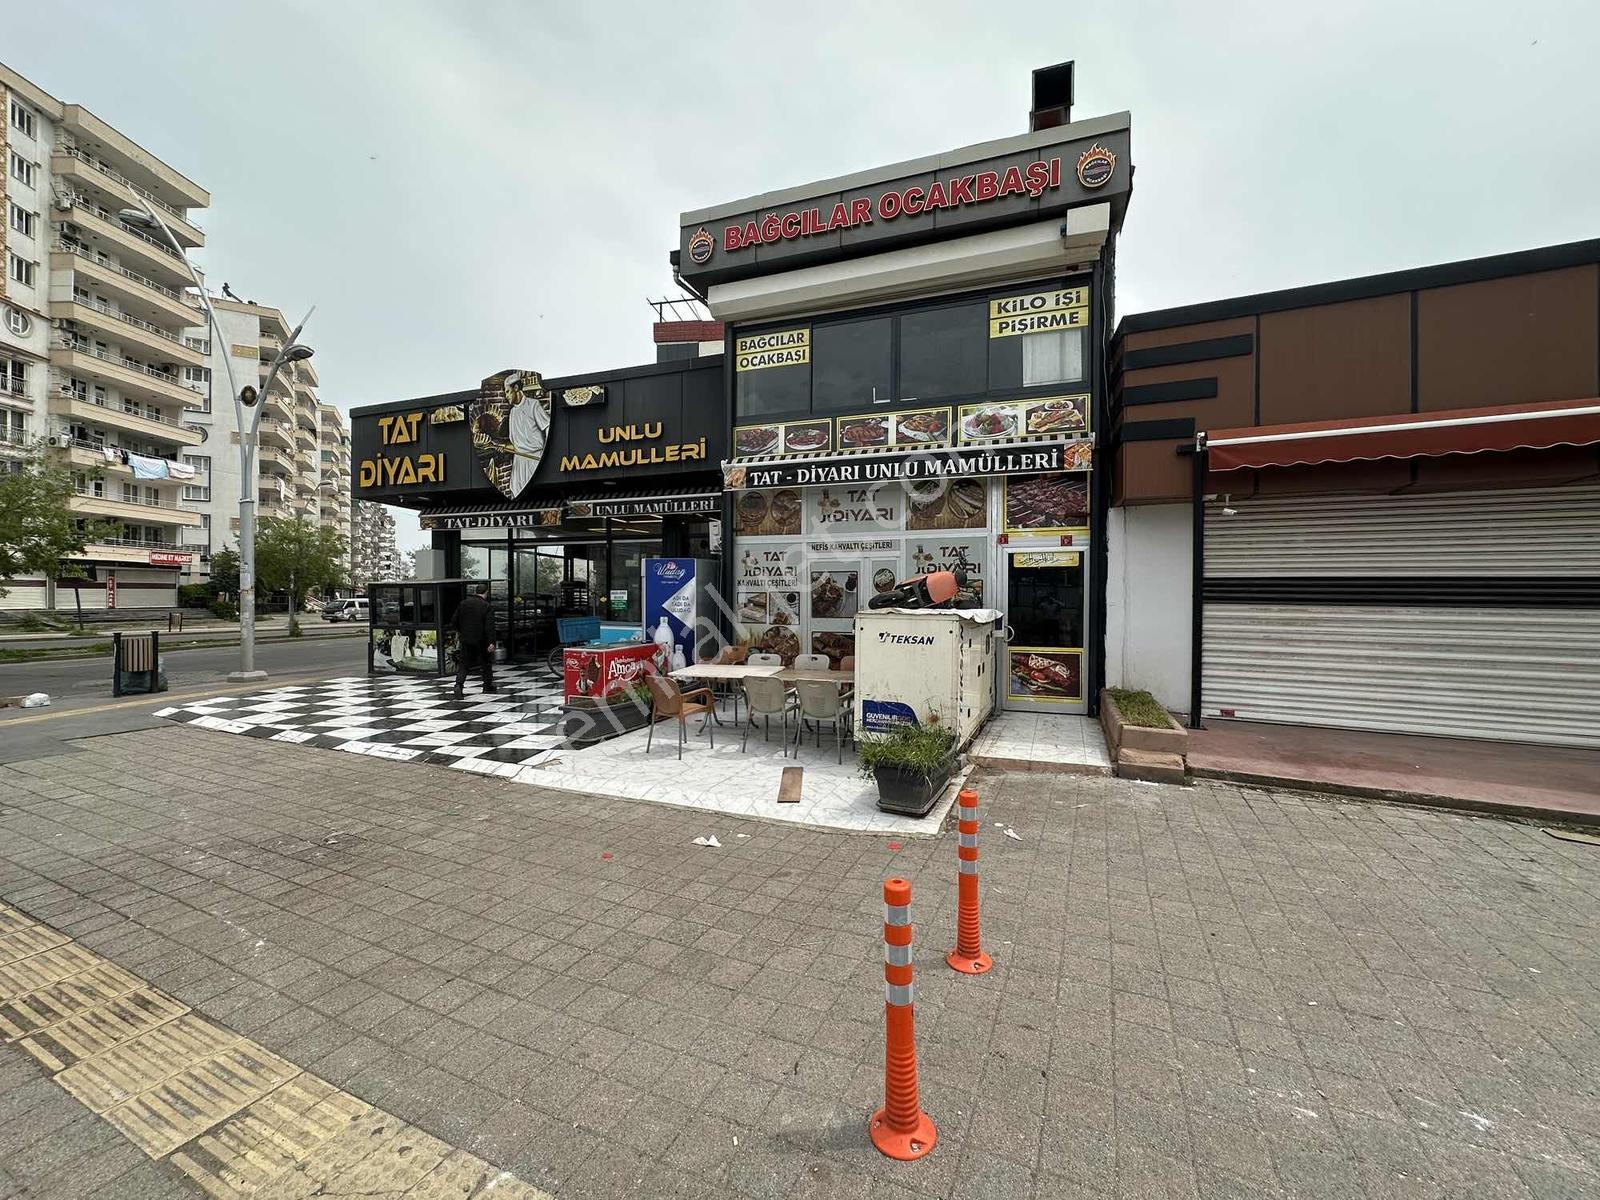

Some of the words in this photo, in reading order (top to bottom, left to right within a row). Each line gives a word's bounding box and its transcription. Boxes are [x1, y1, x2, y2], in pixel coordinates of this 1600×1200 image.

[723, 197, 872, 251] BAĞCILAR
[877, 158, 1062, 220] OCAKBAŞI
[996, 296, 1047, 315] KİLO
[998, 312, 1080, 335] PİŞİRME
[739, 331, 806, 353] BAĞCILAR
[739, 348, 807, 369] OCAKBAŞI
[377, 412, 424, 446] TAT
[598, 421, 663, 444] UNLU
[559, 437, 707, 472] MAMULLERİ
[359, 452, 445, 488] DİYARI
[750, 470, 783, 486] TAT
[797, 463, 860, 485] DİYARI
[865, 460, 919, 480] UNLU
[923, 447, 1059, 476] MAMÜLLERİ
[847, 488, 880, 503] TAT
[596, 503, 633, 516] UNLU
[635, 499, 715, 514] MAMÜLLERİ
[763, 551, 788, 562] TAT
[940, 546, 969, 558] TAT
[890, 635, 935, 646] TEKSAN
